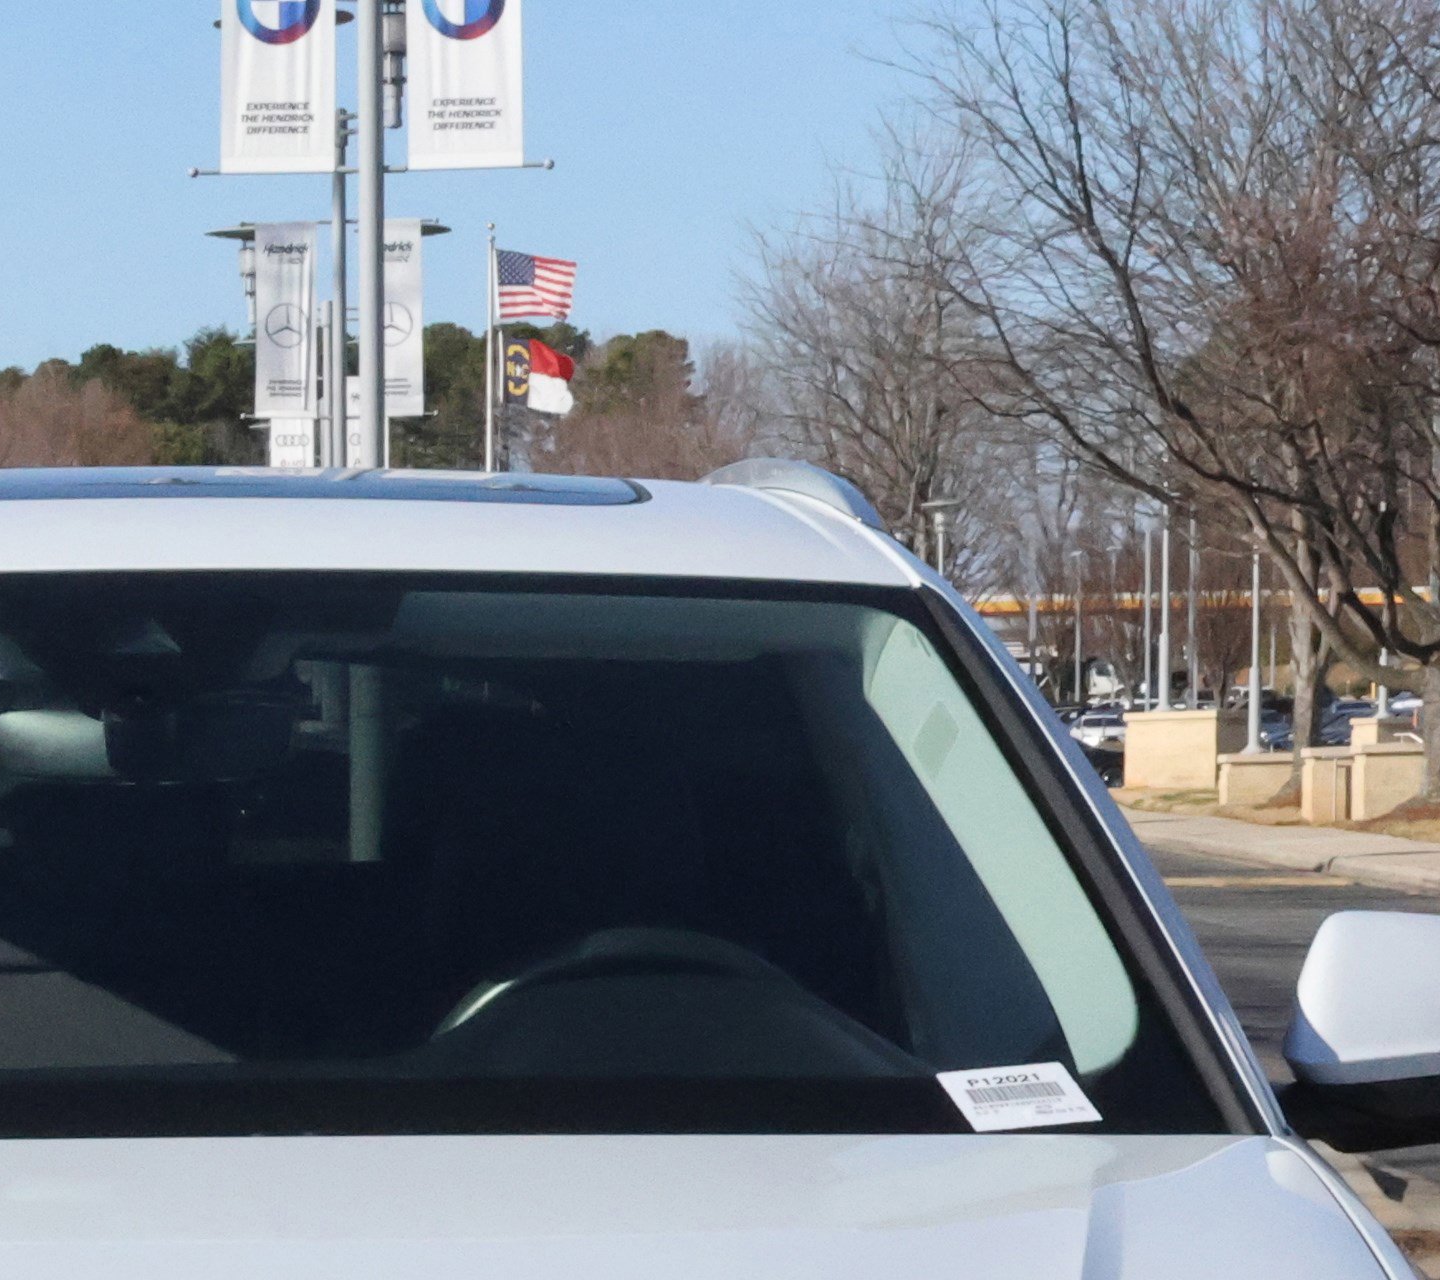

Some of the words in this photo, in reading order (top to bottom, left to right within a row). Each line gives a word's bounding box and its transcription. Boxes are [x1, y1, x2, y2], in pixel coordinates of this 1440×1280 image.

[433, 97, 496, 106] EXPERIENCE
[246, 102, 310, 111] EXPERIENCE
[241, 114, 260, 122] THE
[427, 110, 447, 119] THE
[433, 121, 496, 130] DIFFERENCE
[246, 126, 310, 135] DIFFERENCE
